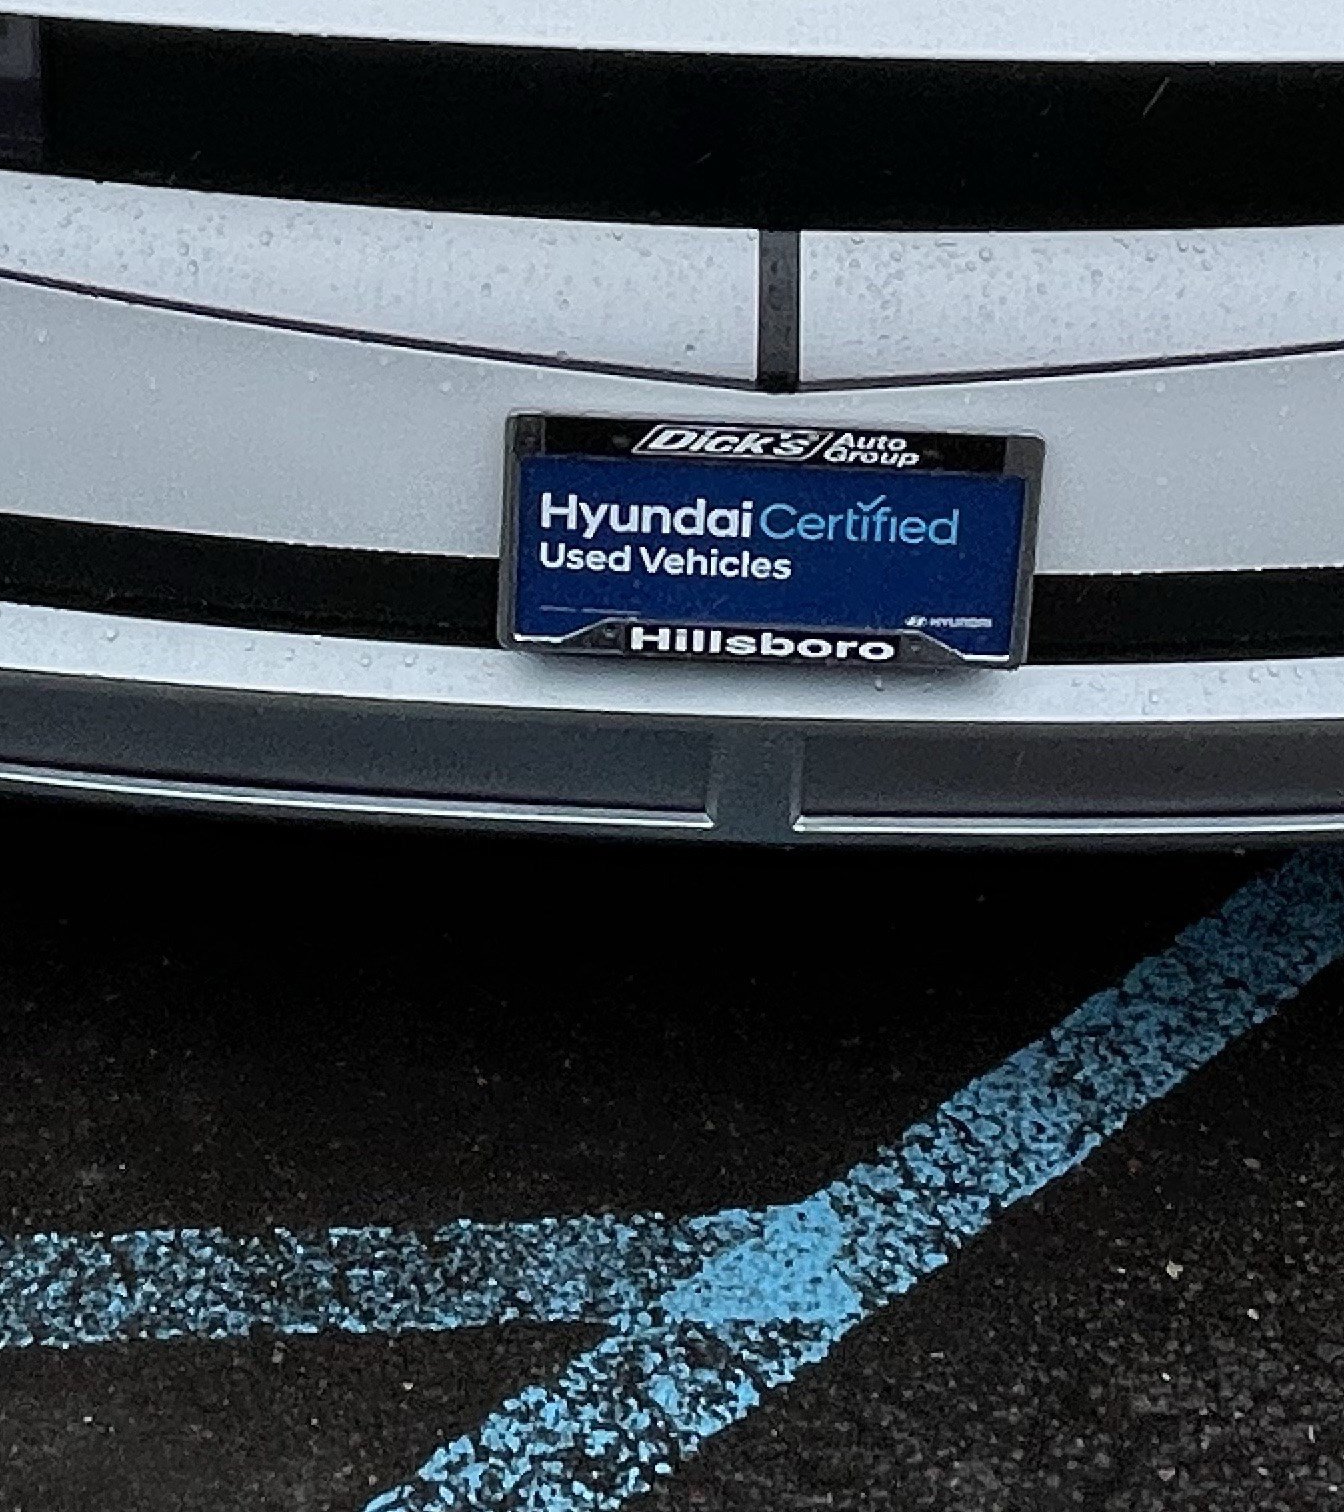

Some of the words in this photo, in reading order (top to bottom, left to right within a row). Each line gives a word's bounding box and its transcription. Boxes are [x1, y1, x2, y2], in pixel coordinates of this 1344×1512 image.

[824, 446, 920, 467] Group
[833, 432, 907, 451] Auto
[540, 492, 753, 539] Hyundai
[760, 495, 959, 545] Certified
[540, 543, 631, 572] Used
[639, 547, 792, 579] Vehicles
[630, 627, 895, 661] Hillsboro
